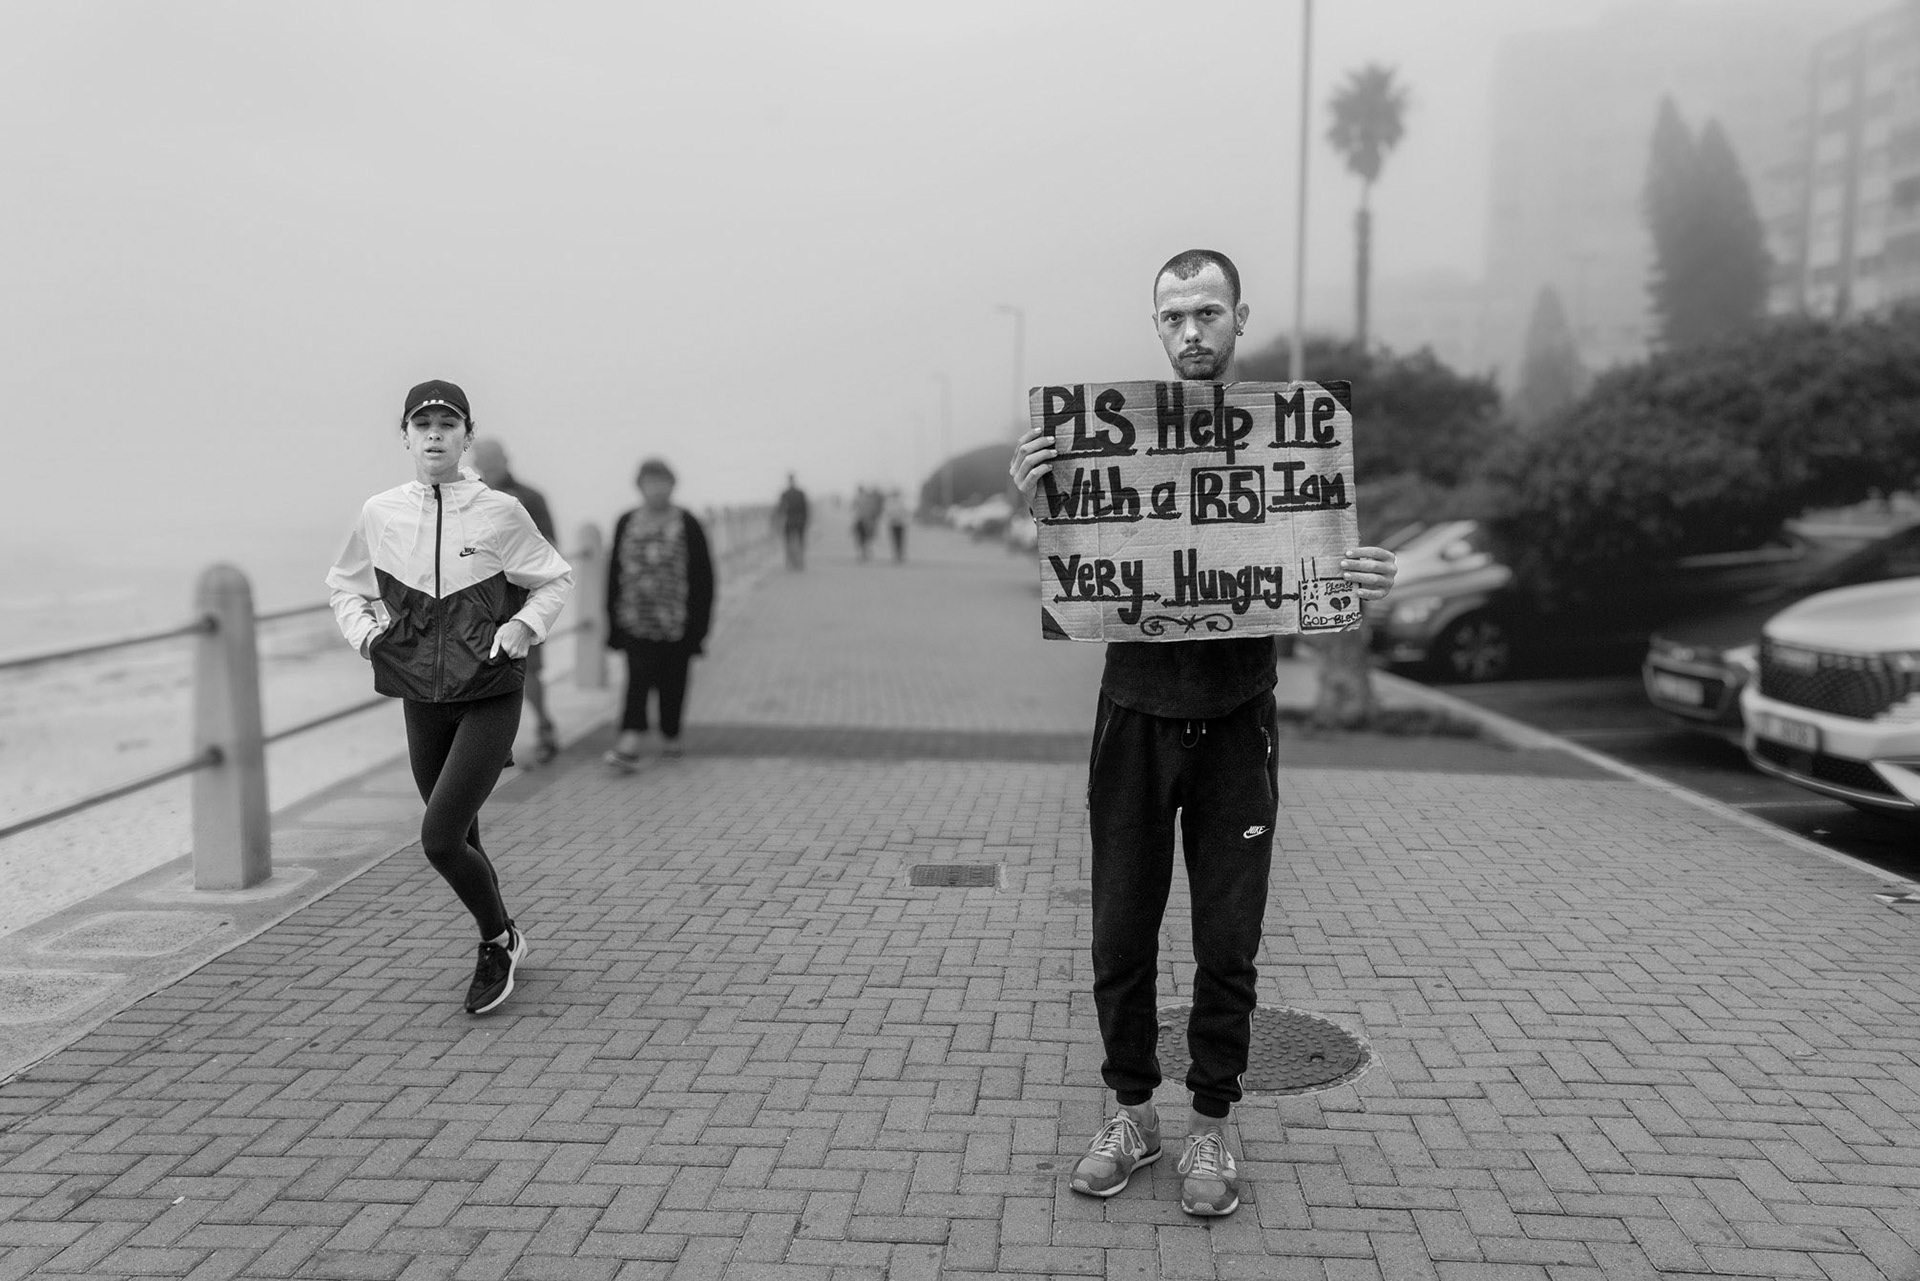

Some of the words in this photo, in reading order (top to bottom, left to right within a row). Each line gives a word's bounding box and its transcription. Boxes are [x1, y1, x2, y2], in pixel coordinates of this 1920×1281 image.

[1043, 385, 1136, 451] PLS
[1155, 382, 1253, 464] Help
[1274, 388, 1336, 443] Me
[1042, 466, 1140, 518] With
[1199, 472, 1260, 519] R5
[1173, 548, 1283, 614] Hungry
[1303, 614, 1328, 626] GOD
